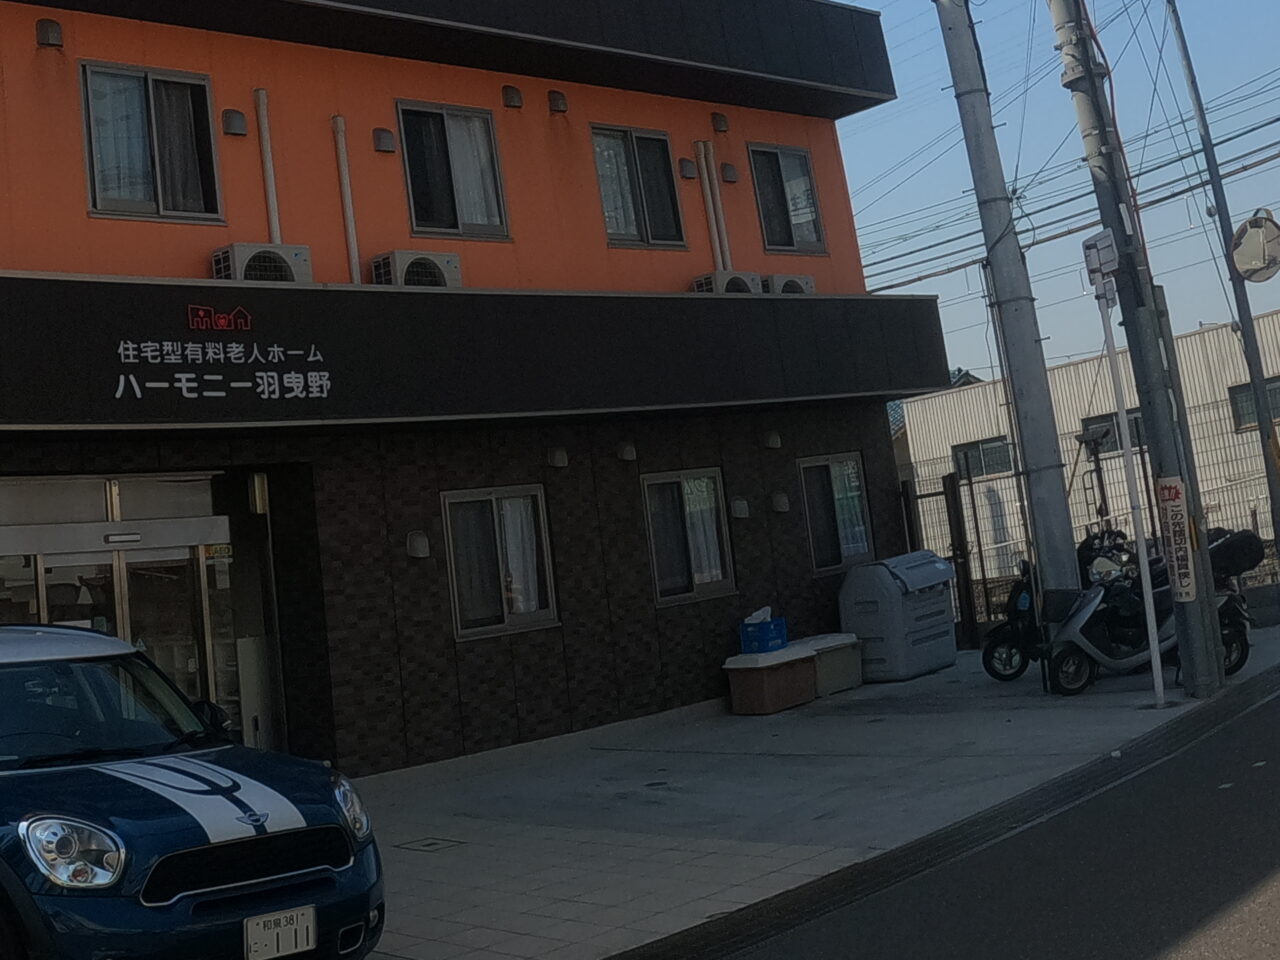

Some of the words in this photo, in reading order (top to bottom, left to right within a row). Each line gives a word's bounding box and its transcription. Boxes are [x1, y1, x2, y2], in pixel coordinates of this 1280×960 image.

[118, 341, 324, 364] 住宅型有料老人ホーム
[115, 371, 331, 399] ハーモニー羽曳野
